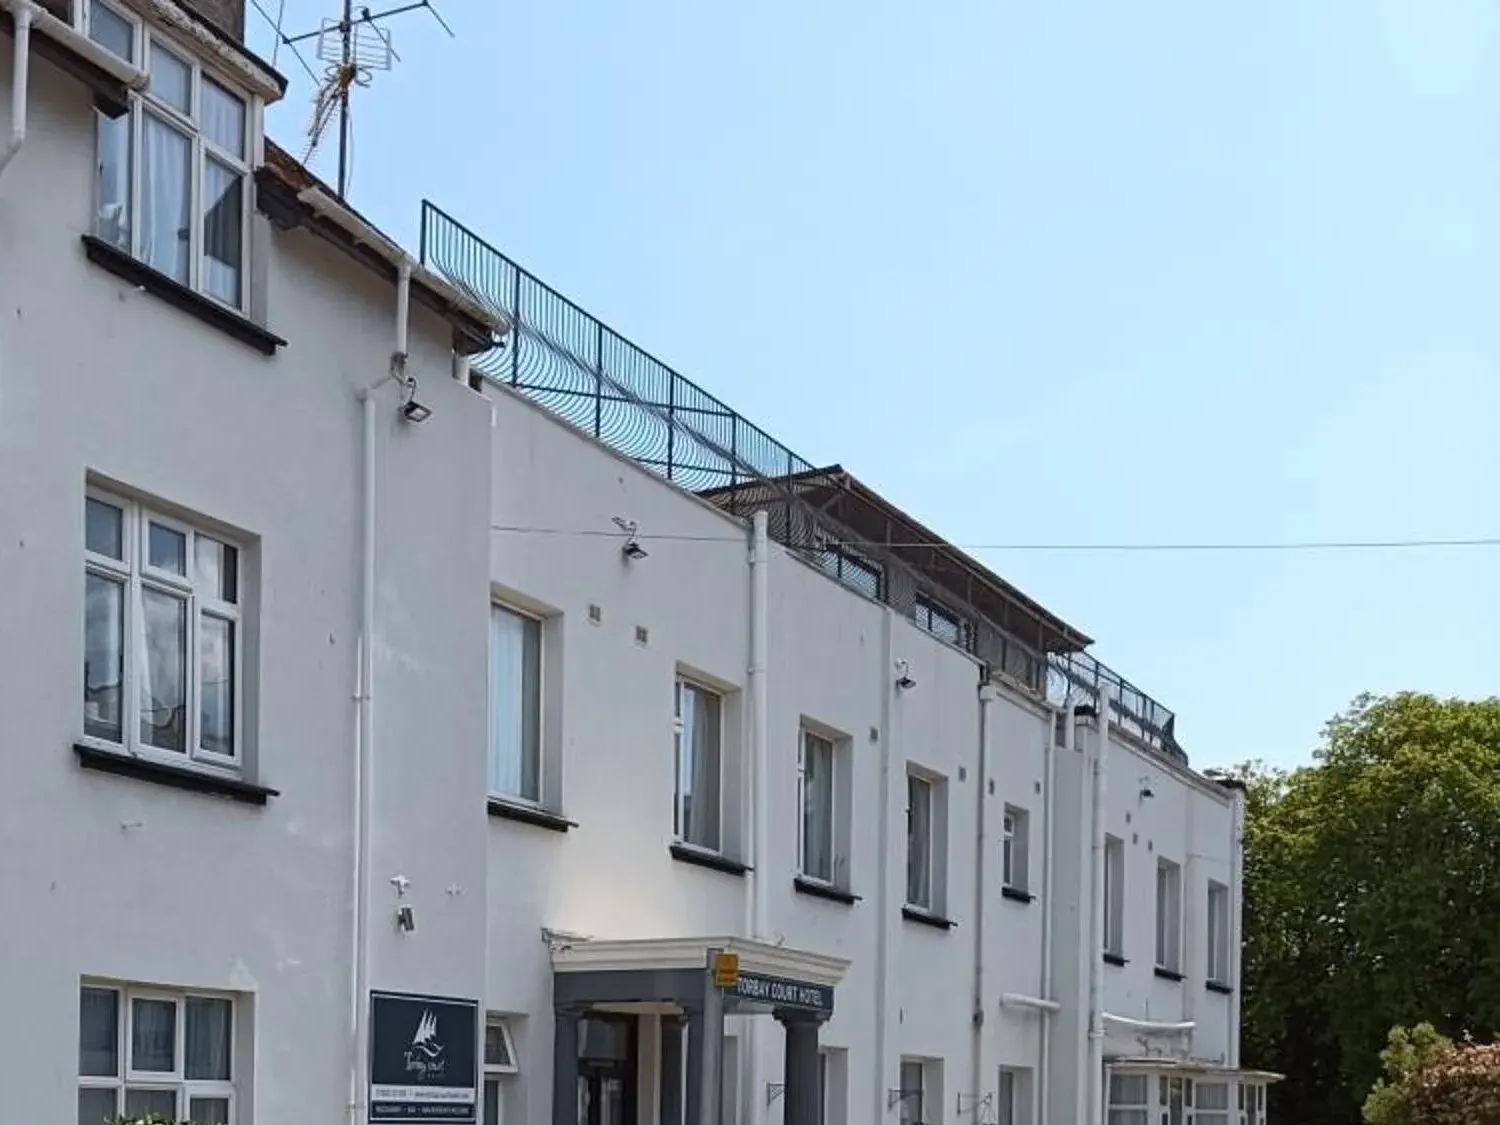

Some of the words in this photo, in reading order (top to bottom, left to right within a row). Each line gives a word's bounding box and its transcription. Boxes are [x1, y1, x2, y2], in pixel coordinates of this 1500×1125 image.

[738, 977, 770, 997] TORBAY
[771, 984, 798, 1001] COURT
[800, 988, 823, 1006] HOTEL
